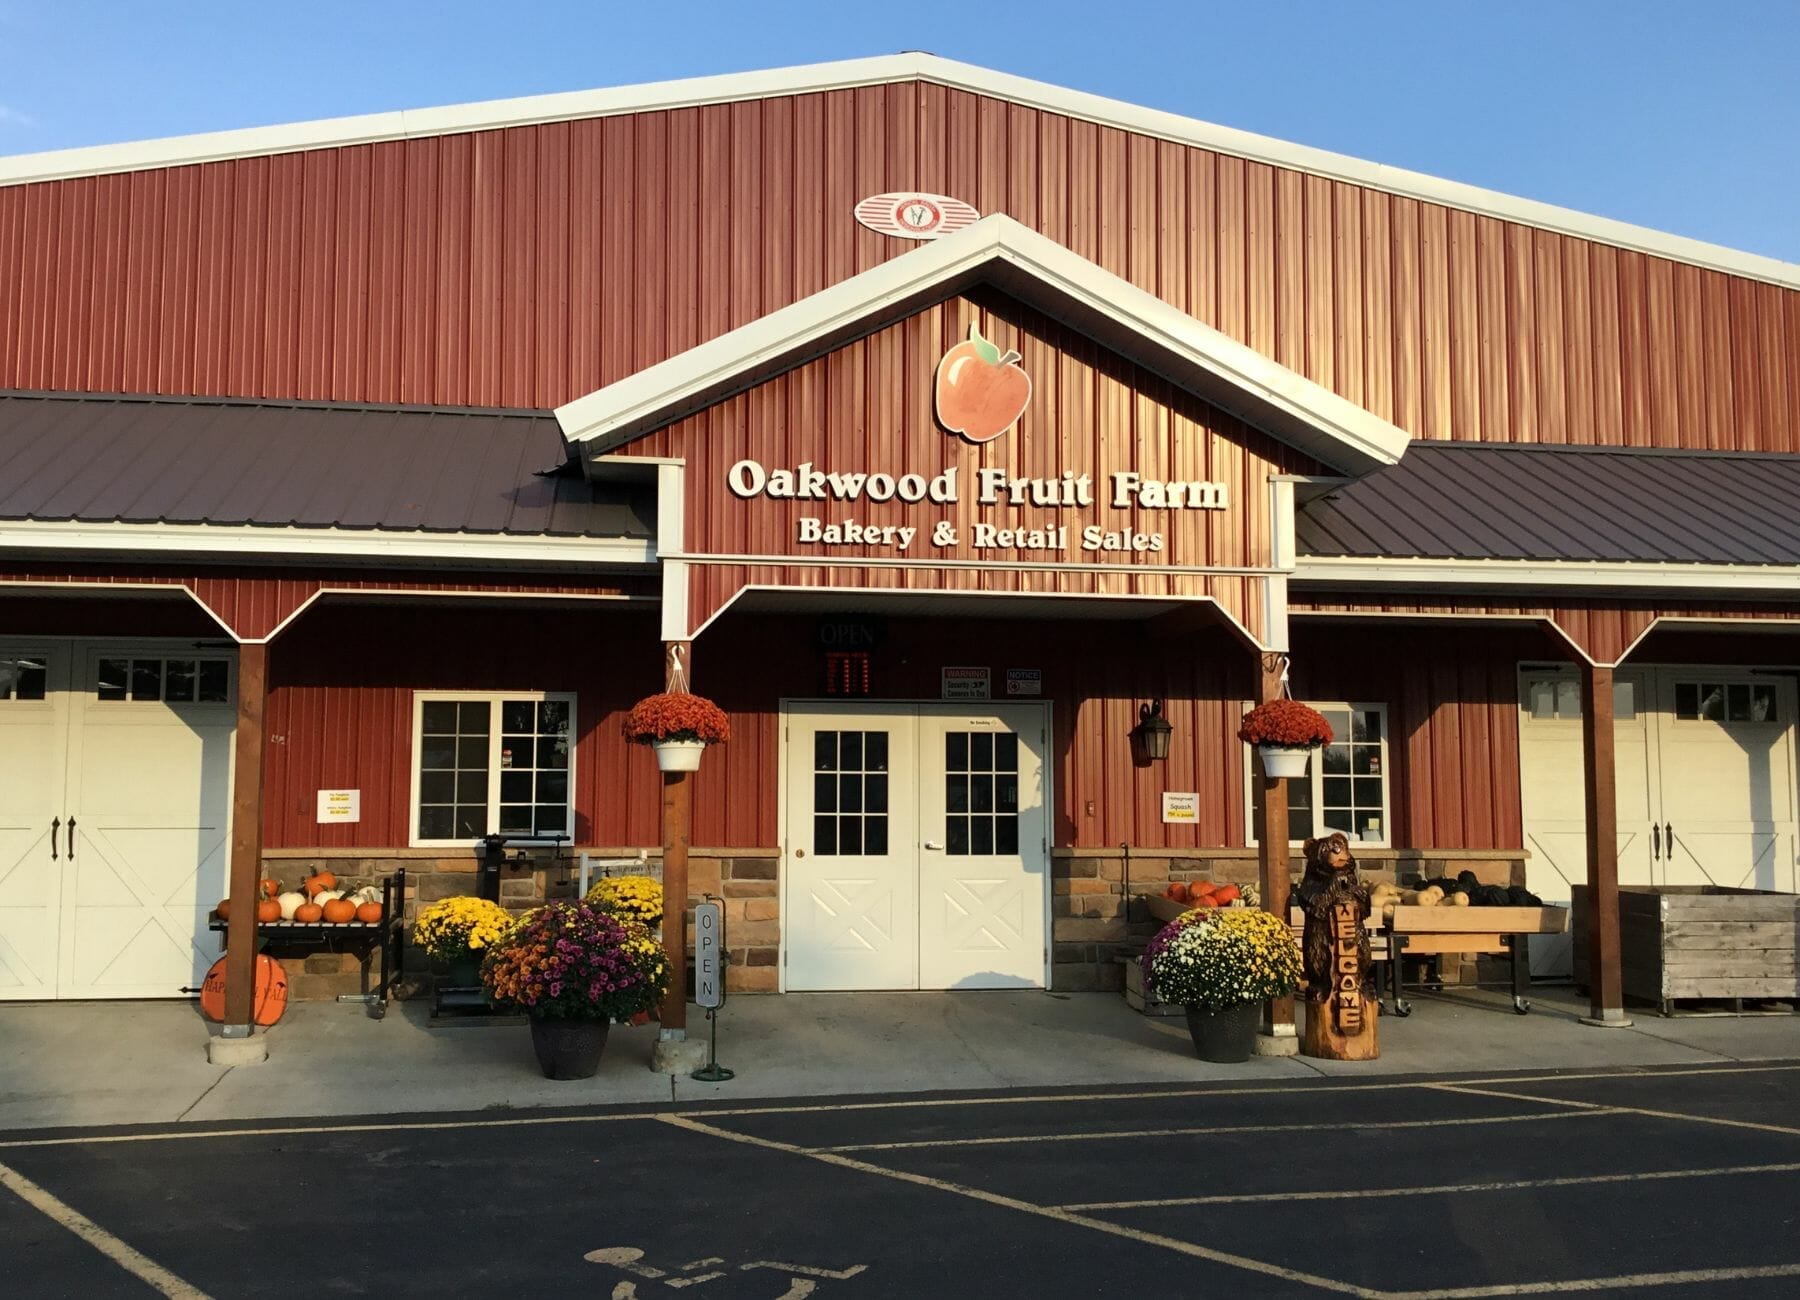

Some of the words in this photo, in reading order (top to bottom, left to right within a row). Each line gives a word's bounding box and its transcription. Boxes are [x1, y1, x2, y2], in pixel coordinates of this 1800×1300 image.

[728, 459, 959, 503] Oakwood
[978, 467, 1094, 507] Fruit
[1111, 471, 1230, 510] Farm
[799, 517, 917, 549] Bakery
[932, 520, 960, 547] &
[974, 523, 1067, 550] Retail
[1081, 525, 1164, 552] Sales
[820, 623, 874, 645] OPEN
[946, 669, 986, 679] WARNING
[1008, 671, 1039, 680] NOTICE
[1170, 803, 1192, 811] Squash
[702, 914, 712, 996] OPEN
[1334, 903, 1361, 1028] WELCOME
